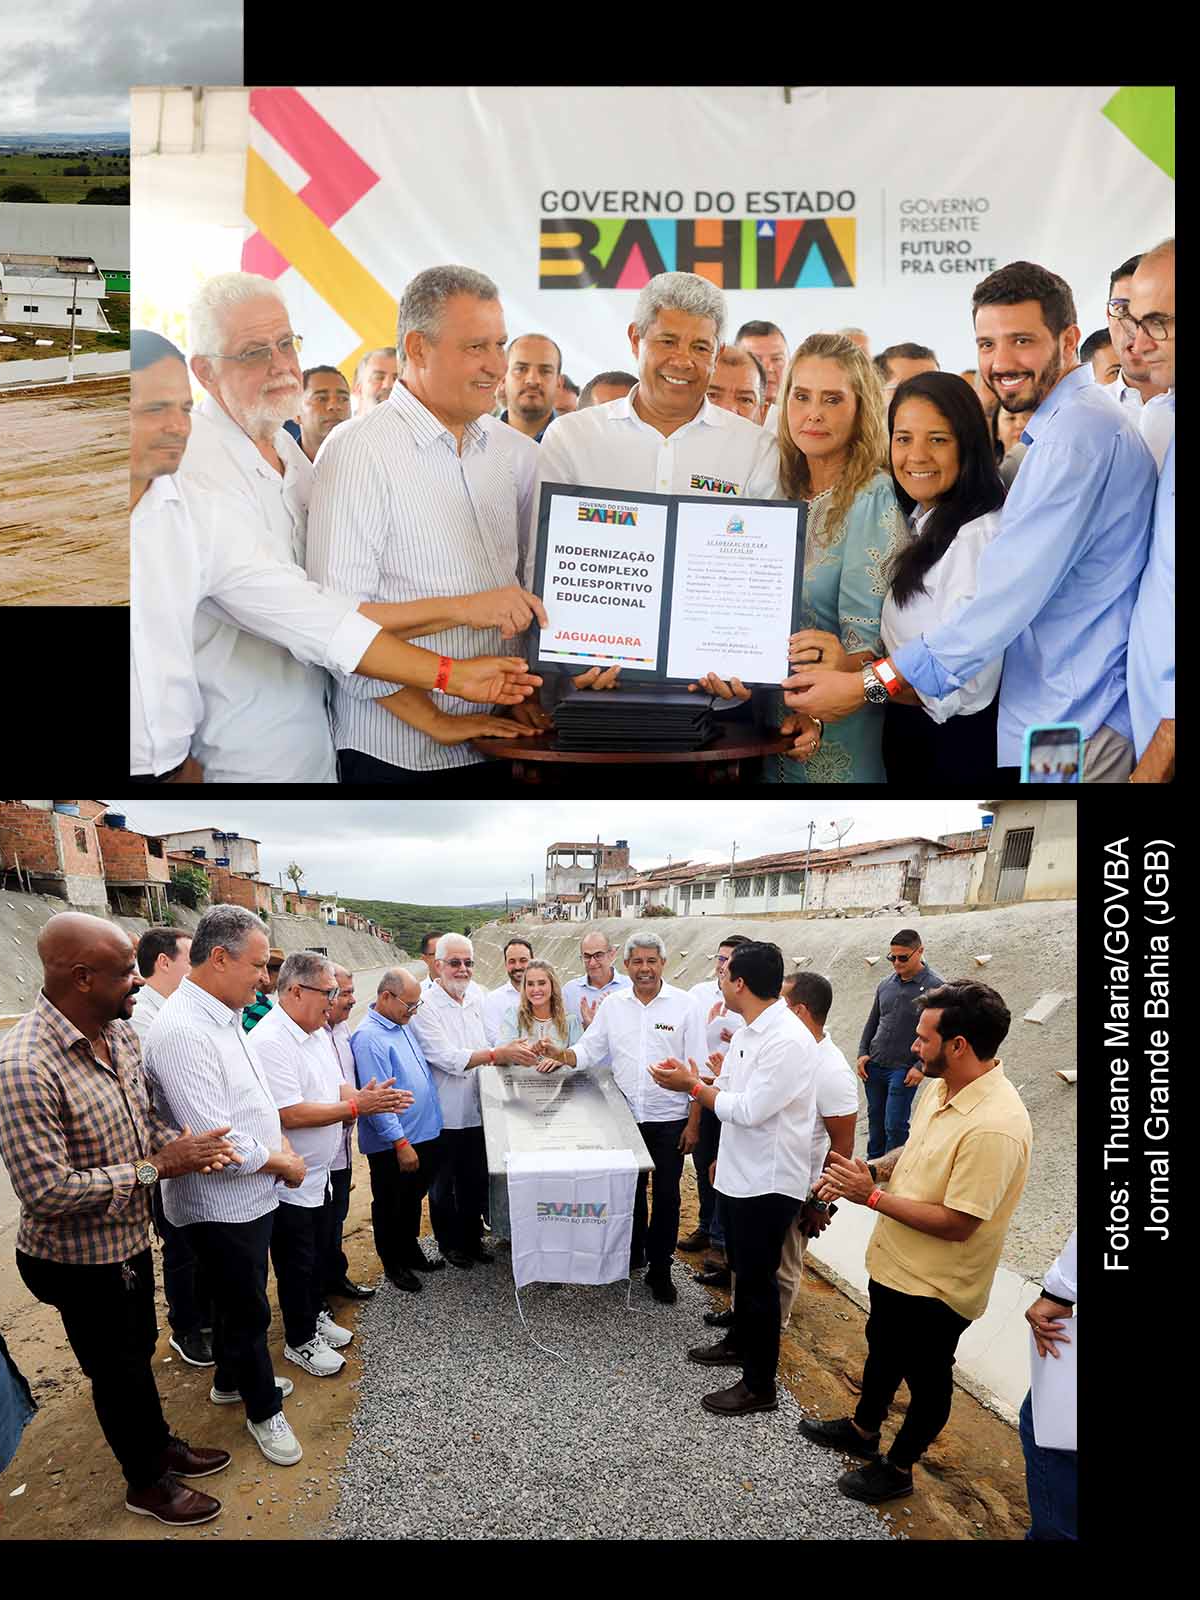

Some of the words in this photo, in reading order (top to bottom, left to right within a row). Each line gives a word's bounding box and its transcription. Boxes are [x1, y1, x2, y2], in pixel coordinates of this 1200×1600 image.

[541, 190, 684, 213] GOVERNO
[694, 191, 735, 213] DO
[746, 190, 856, 213] ESTADO
[900, 198, 990, 214] GOVERNO
[900, 217, 980, 232] PRESENTE
[539, 218, 856, 289] BAHIA
[901, 240, 971, 255] FUTURO
[901, 260, 935, 273] PRA
[939, 258, 997, 273] GENTE
[690, 478, 740, 496] BAHIA
[578, 507, 638, 526] BAHIA
[554, 544, 655, 563] MODERNIZAÇÃO
[559, 560, 576, 571] DO
[580, 562, 649, 578] COMPLEXO
[552, 576, 653, 594] POLIESPORTIVO
[556, 592, 646, 609] EDUCACIONAL
[554, 631, 641, 648] JAGUAQUARA
